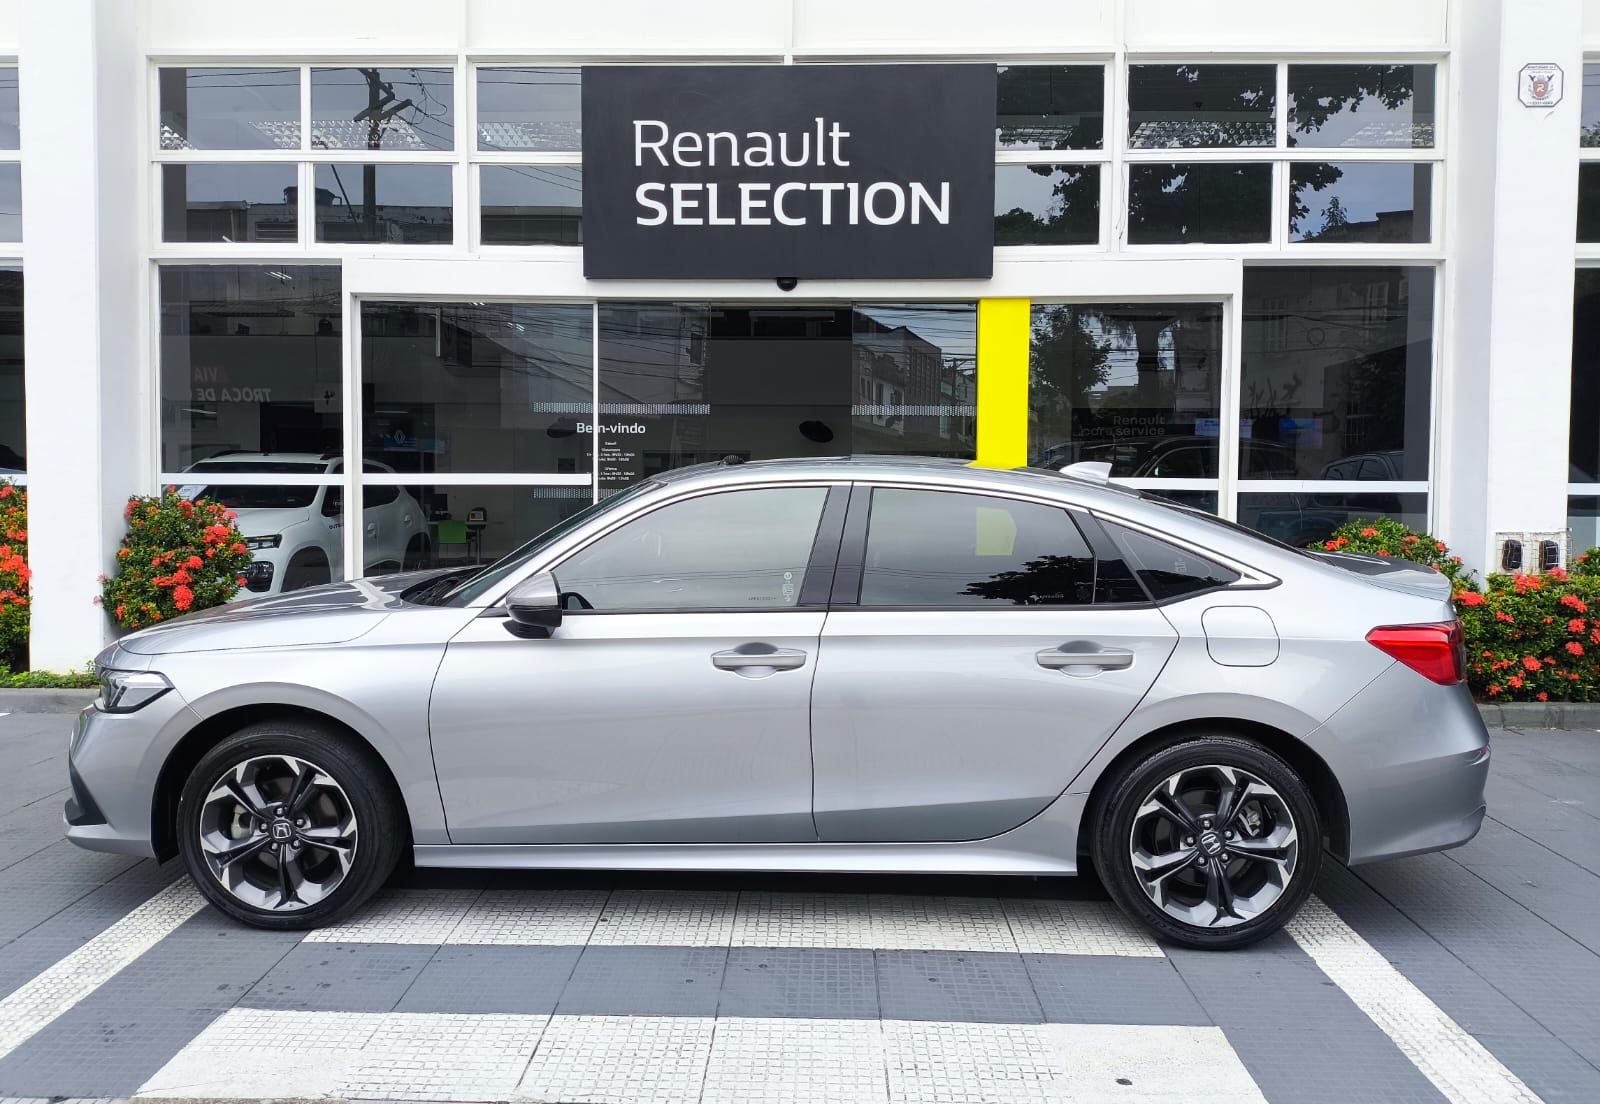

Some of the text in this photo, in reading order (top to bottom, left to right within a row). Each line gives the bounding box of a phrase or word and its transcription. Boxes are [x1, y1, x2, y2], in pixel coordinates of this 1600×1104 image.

[633, 117, 851, 167] Renault
[635, 181, 950, 226] SELECTION
[1113, 415, 1166, 426] Renault
[1115, 425, 1166, 436] service
